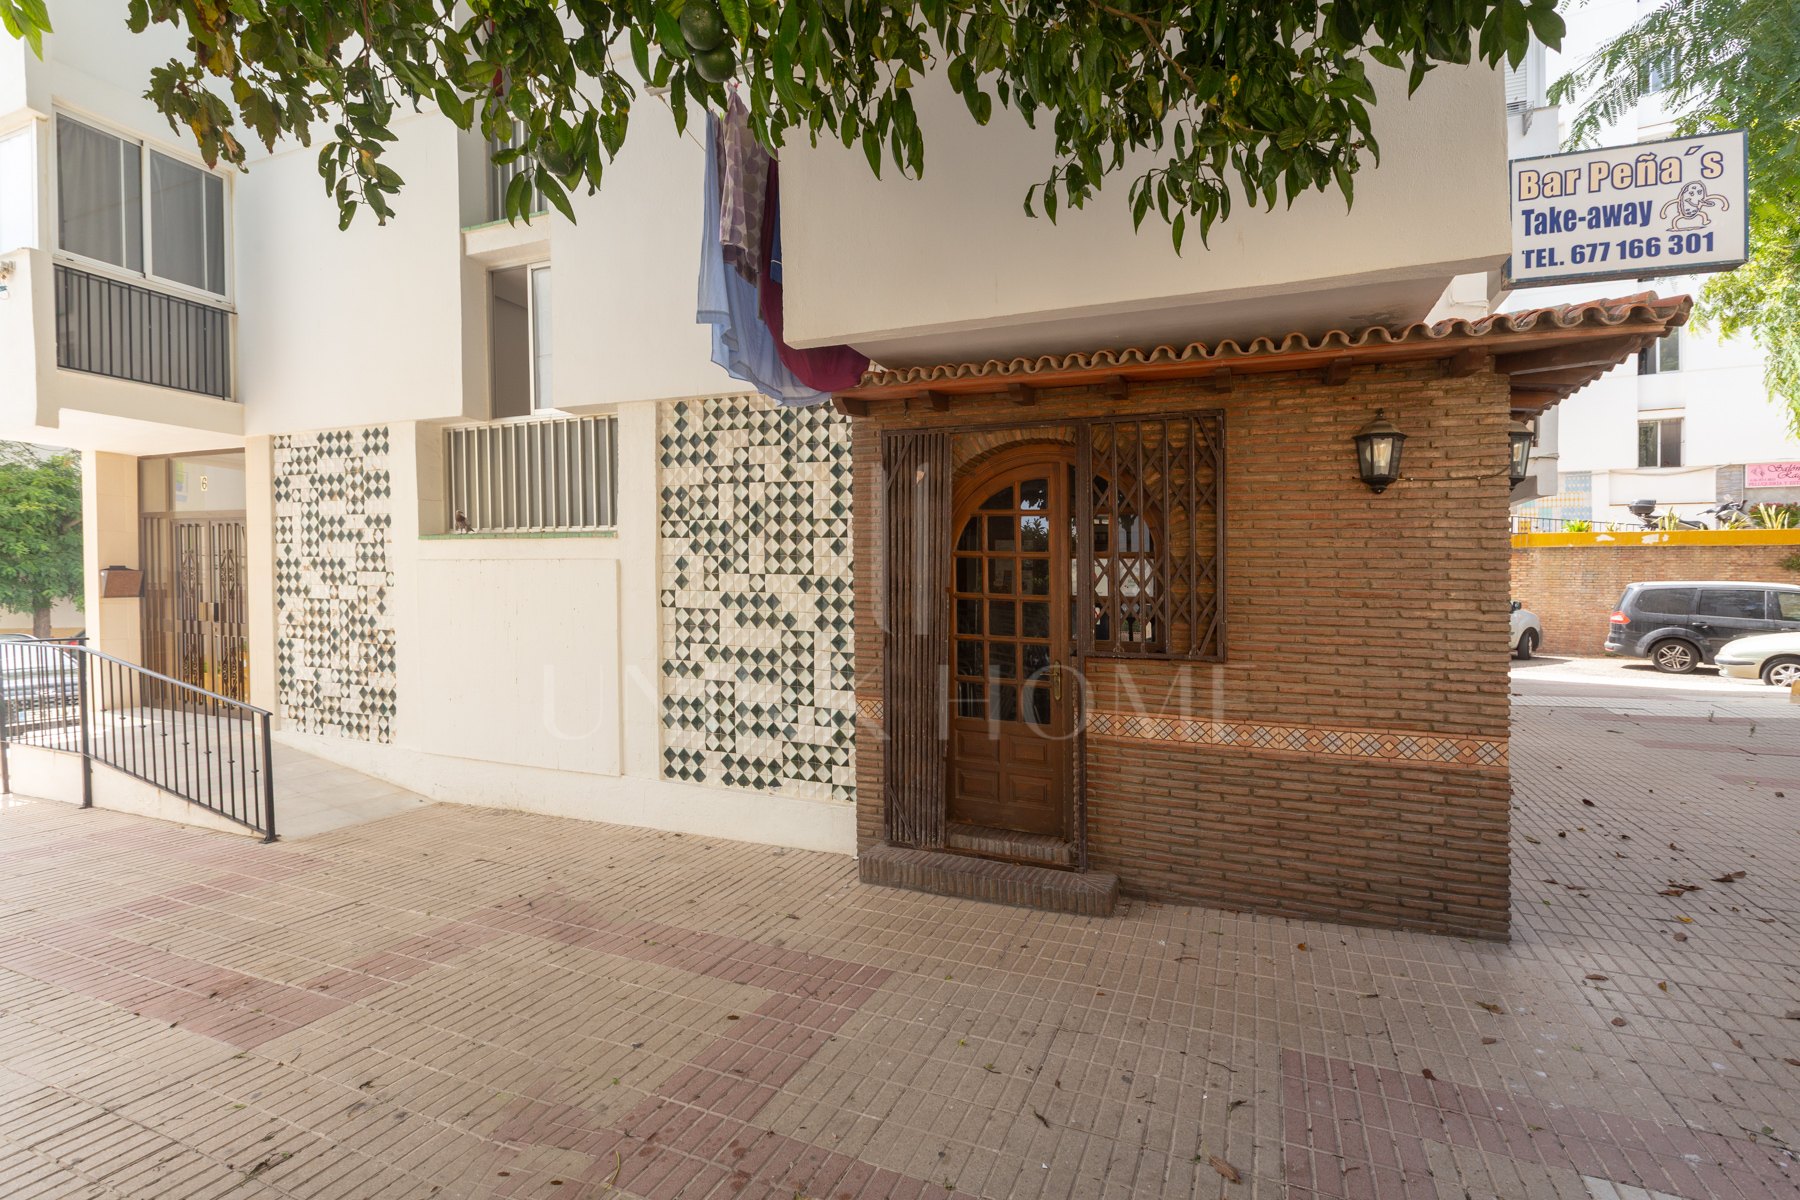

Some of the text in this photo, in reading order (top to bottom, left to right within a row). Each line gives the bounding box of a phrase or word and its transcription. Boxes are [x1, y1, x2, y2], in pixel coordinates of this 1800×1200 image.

[1518, 168, 1581, 202] Bar
[1521, 200, 1653, 236] Take-away
[1521, 231, 1714, 269] TEL. 677 166 301
[201, 476, 208, 490] 6
